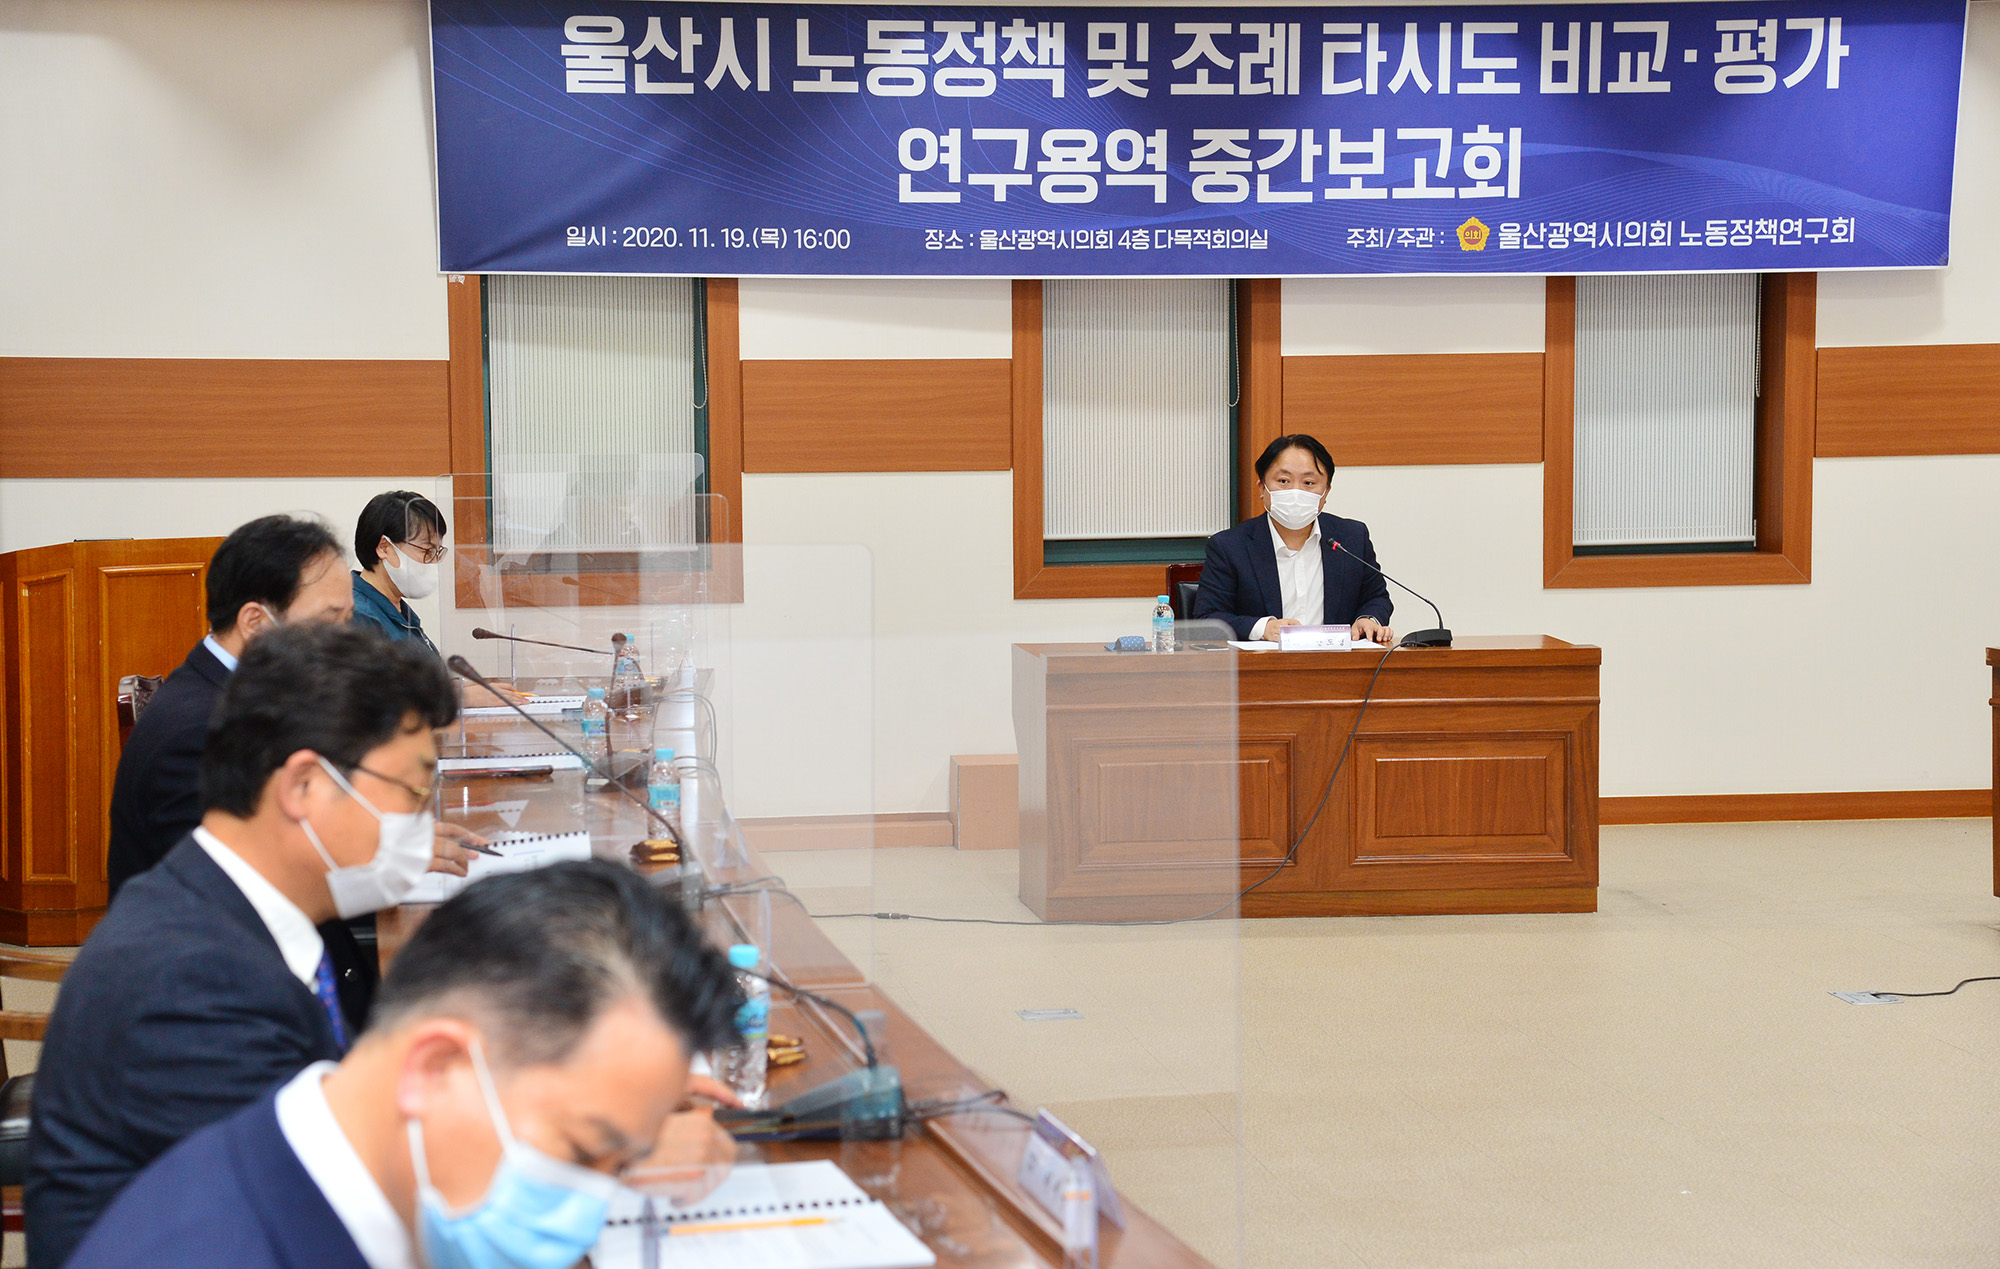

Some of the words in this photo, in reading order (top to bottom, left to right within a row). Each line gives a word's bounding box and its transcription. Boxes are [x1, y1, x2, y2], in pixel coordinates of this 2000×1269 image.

[560, 15, 770, 95] 울산시
[793, 18, 1065, 98] 노동정책
[1086, 22, 1149, 98] 및
[1170, 22, 1301, 95] 조례
[1321, 22, 1521, 95] 타시도
[897, 127, 1168, 204] 연구용역
[1188, 124, 1522, 204] 중간보고회
[622, 226, 683, 248] 2020.
[688, 227, 715, 248] 11.
[793, 228, 851, 250] 16:00
[979, 228, 1114, 251] 울산광역시의회
[1117, 228, 1151, 250] 4층
[1154, 228, 1269, 250] 다목적회의실
[1498, 219, 1673, 250] 울산광역시의회
[1678, 216, 1856, 247] 노동정책연구회
